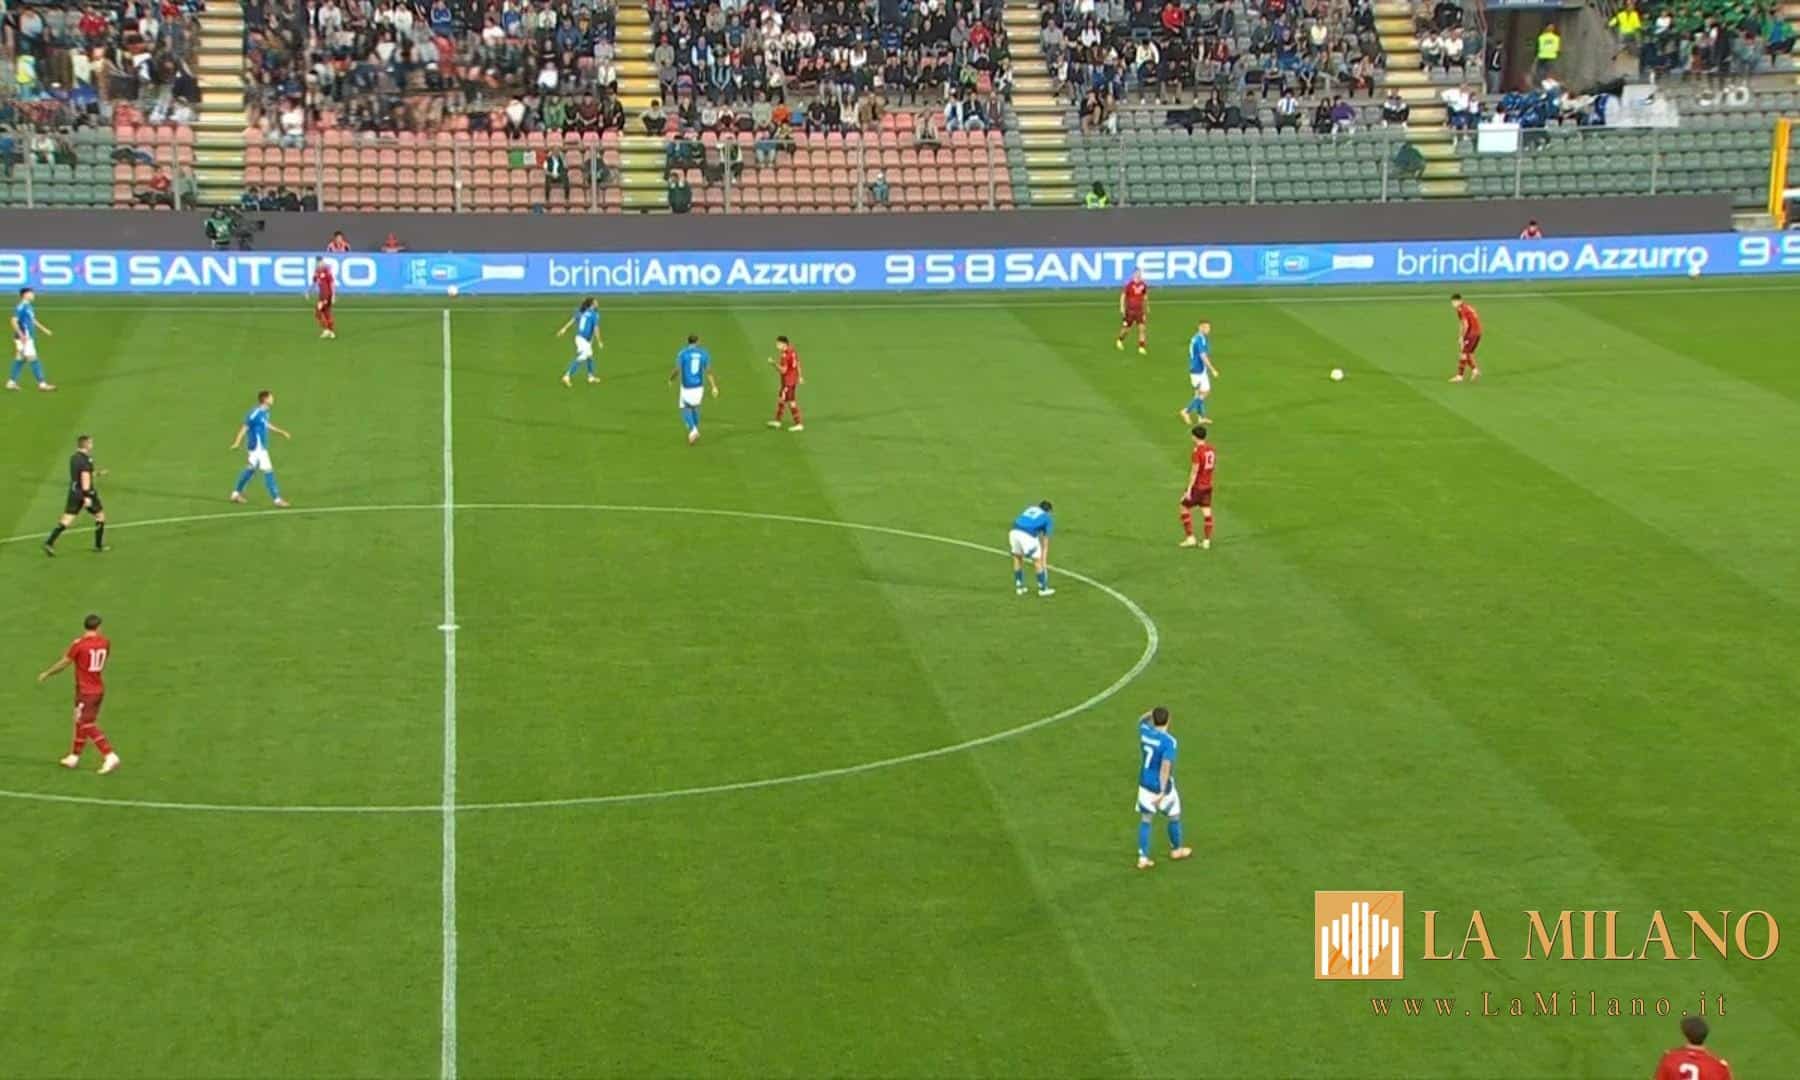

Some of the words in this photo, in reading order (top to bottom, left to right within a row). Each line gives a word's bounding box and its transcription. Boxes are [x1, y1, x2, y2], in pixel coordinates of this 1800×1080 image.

[549, 259, 721, 286] brindiAmo
[727, 260, 857, 285] Azzurro
[1005, 250, 1232, 283] SANTERO
[1397, 246, 1570, 275] brindiAmo
[1575, 244, 1708, 271] Azzurro
[88, 648, 107, 672] 10
[1143, 744, 1153, 769] 7
